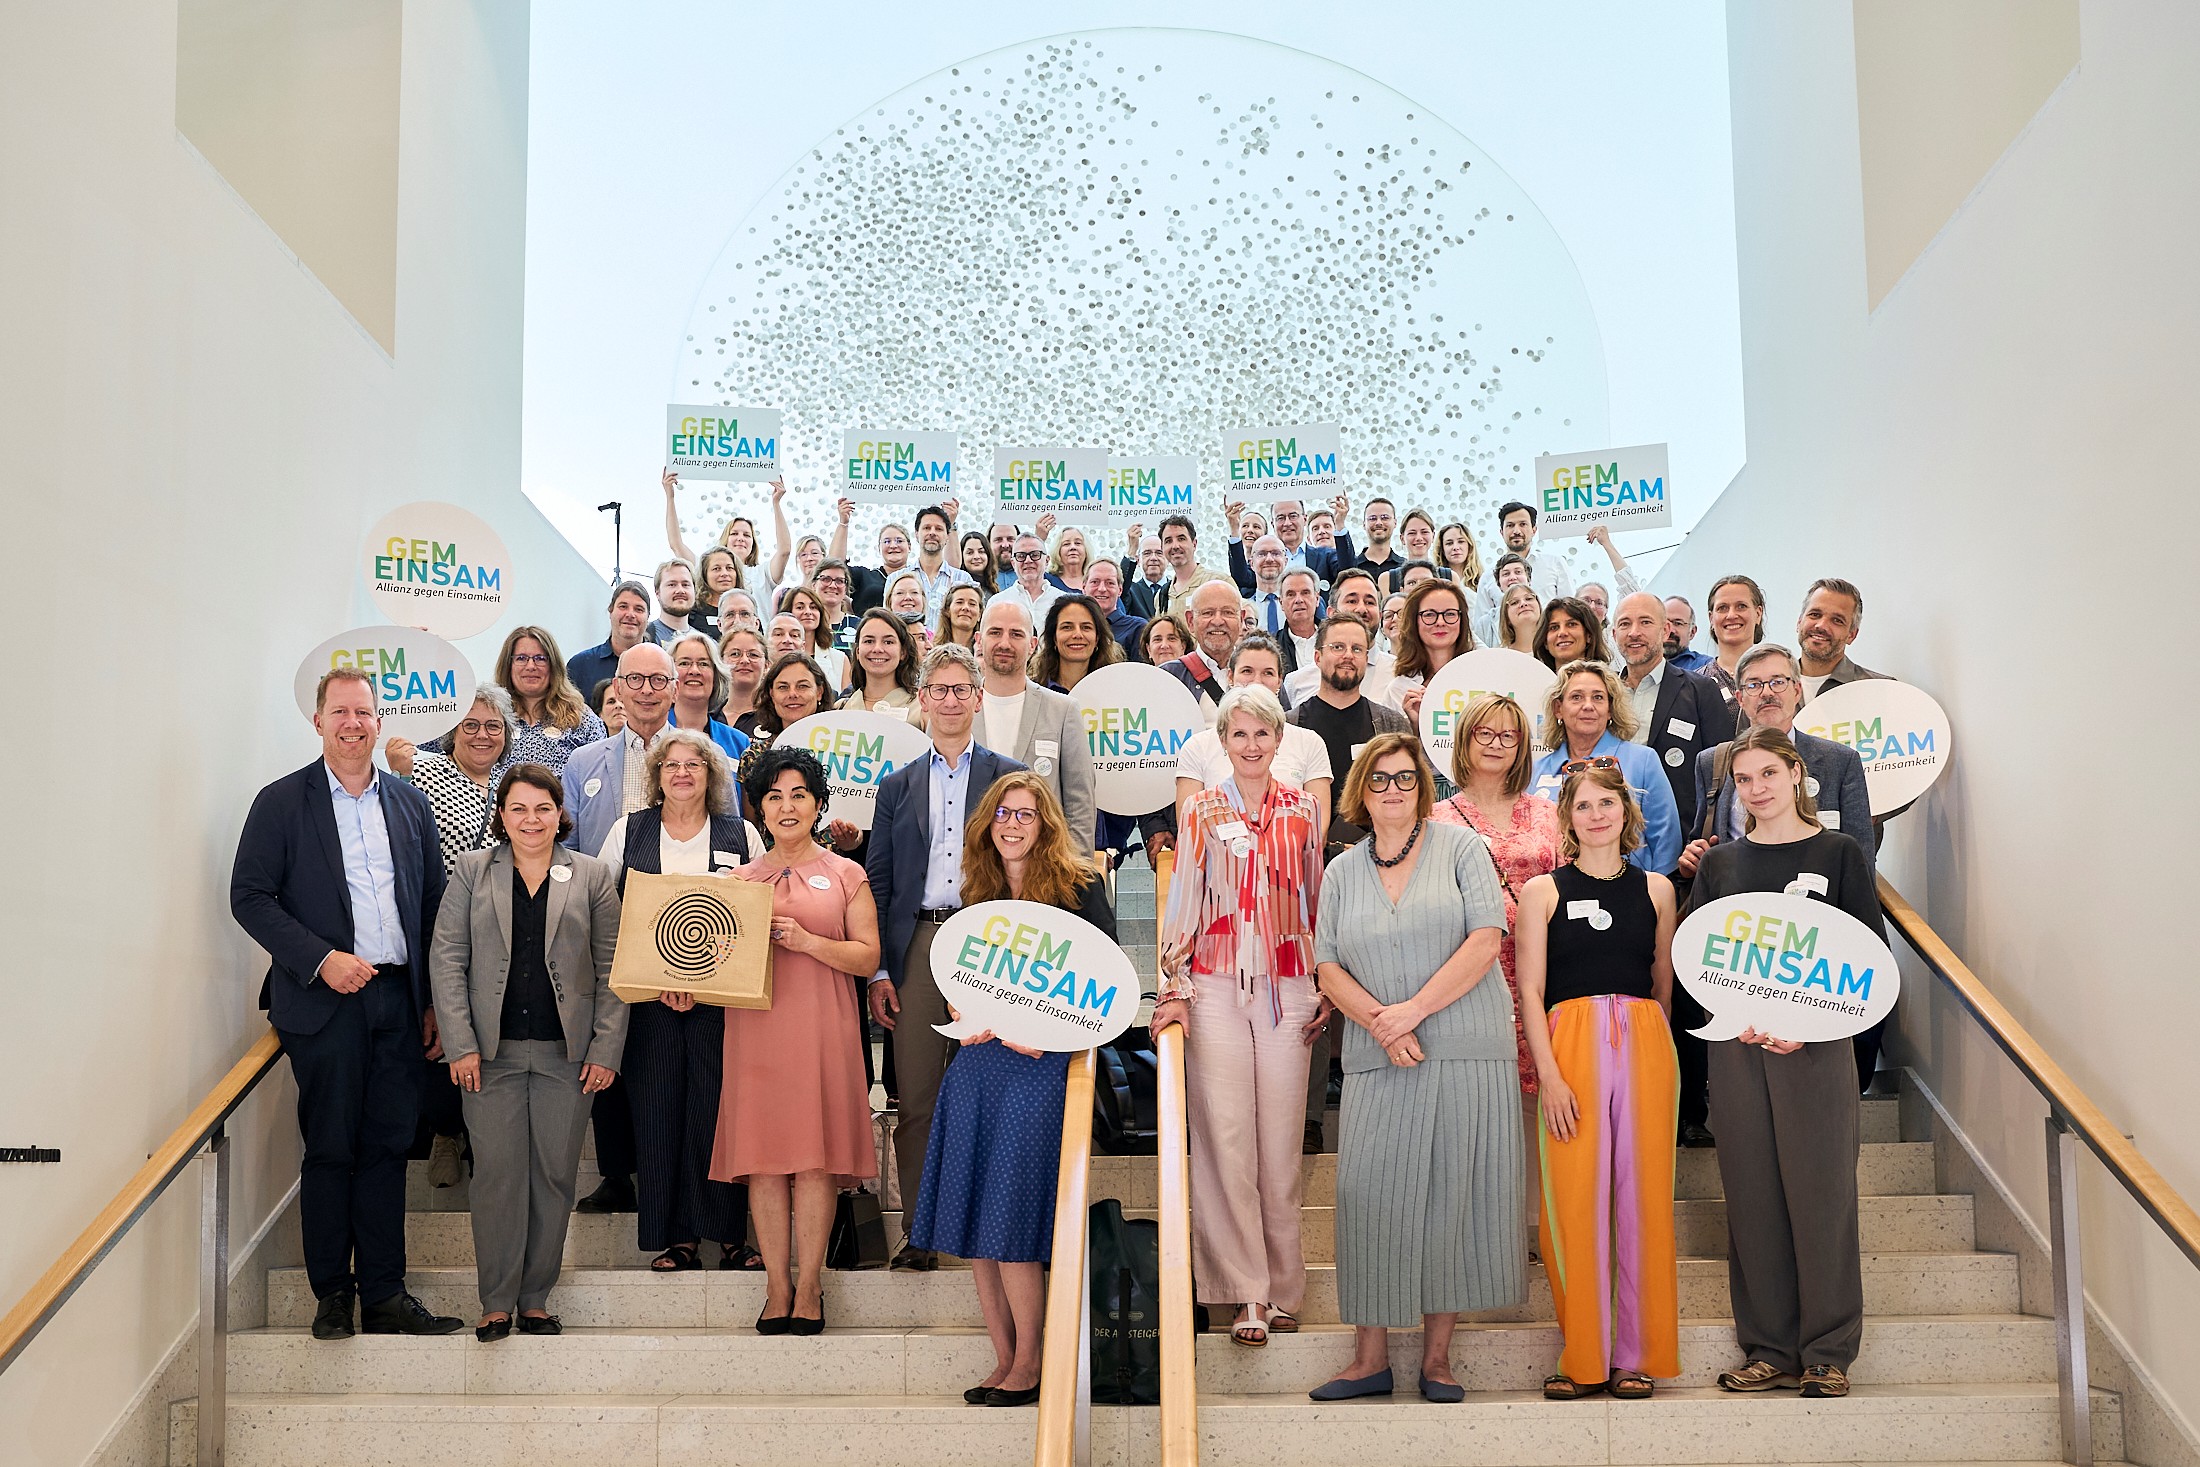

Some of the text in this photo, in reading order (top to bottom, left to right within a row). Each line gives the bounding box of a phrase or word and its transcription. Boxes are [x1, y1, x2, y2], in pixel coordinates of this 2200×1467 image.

[681, 416, 738, 439] GEM
[672, 434, 774, 459] EINSAM
[858, 440, 914, 463] GEM
[1238, 437, 1297, 462] GEM
[672, 458, 774, 469] Allianz gegen Einsamkeit
[848, 459, 951, 482] EINSAM
[1009, 460, 1065, 482] GEM
[1230, 453, 1336, 480] EINSAM
[848, 482, 950, 493] Allianz gegen Einsamkeit
[1231, 476, 1336, 491] Allianz gegen Einsamkeit
[1552, 462, 1619, 491] GEM
[1000, 479, 1102, 500] EINSAM
[1110, 485, 1192, 506] INSAM
[1543, 477, 1664, 512] EINSAM
[1001, 503, 1102, 513] Allianz gegen Einsamkeit
[1124, 509, 1147, 517] gegen
[1149, 507, 1192, 516] Einsamkeit
[1545, 504, 1664, 524] Allianz gegen Einsamkeit
[386, 536, 456, 566] GEM
[375, 555, 500, 591] EINSAM
[375, 582, 500, 603] Allianz gegen Einsamkeit
[371, 670, 456, 702] SAM
[378, 702, 457, 718] gen Einsamkeit
[808, 726, 884, 762] GEM
[1088, 729, 1192, 757] INSAM
[1432, 739, 1455, 749] Alli
[1854, 729, 1935, 763] SAM
[1106, 760, 1136, 772] gegen
[1139, 758, 1179, 769] Einsam
[1874, 755, 1936, 773] Einsamkeit
[829, 785, 862, 798] gegen
[982, 915, 1073, 971] GEM
[1724, 909, 1819, 960] GEM
[956, 934, 1118, 1018] EINSAM
[1701, 933, 1874, 1001] EINSAM
[951, 970, 1104, 1033] Allianz gegen Einsamkeit
[1698, 971, 1866, 1017] Allianz gegen Einsamkeit
[1094, 1328, 1160, 1339] DER ASTEIGE
